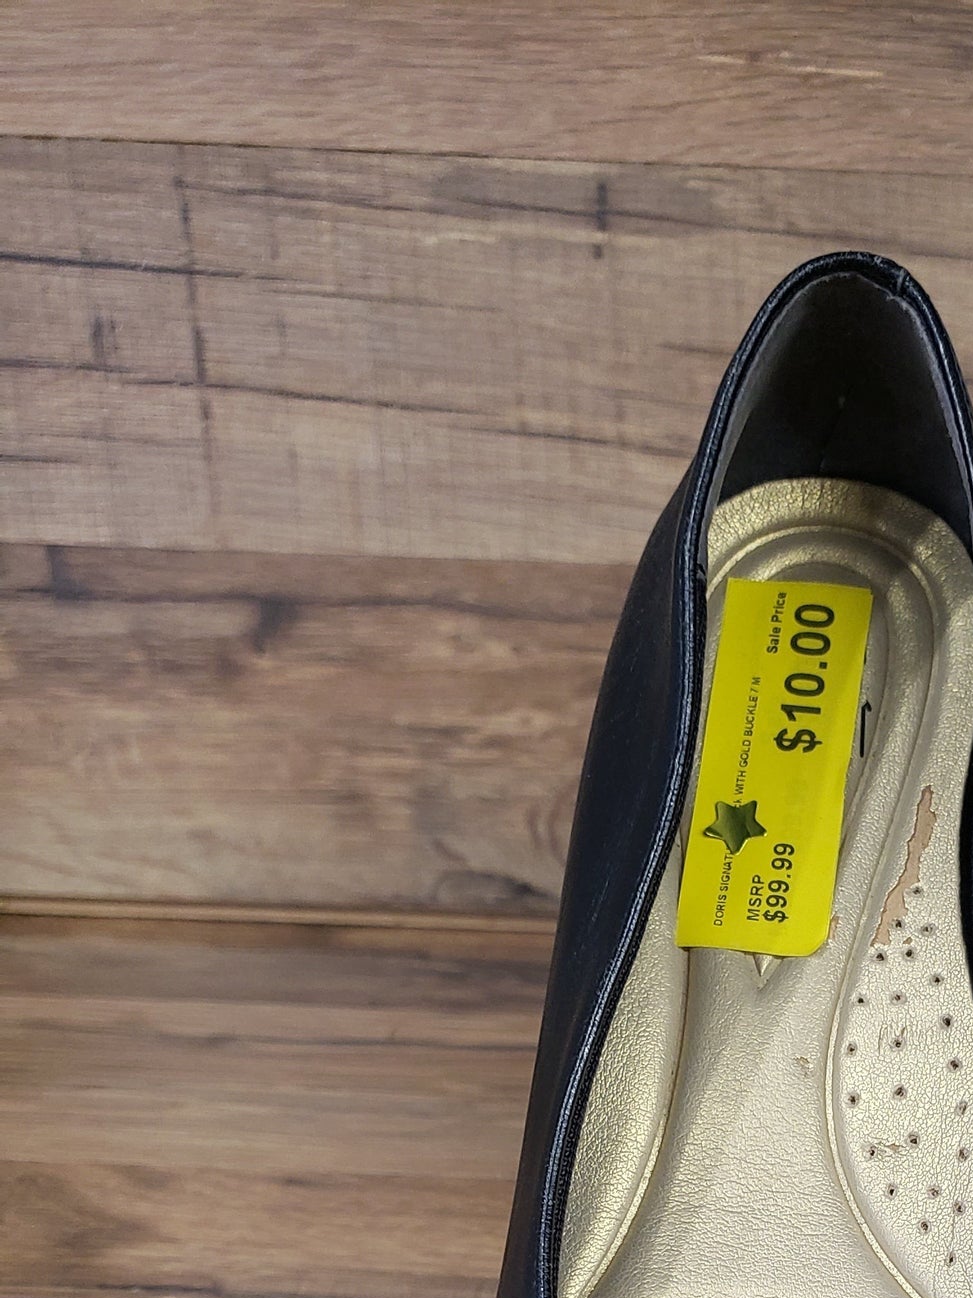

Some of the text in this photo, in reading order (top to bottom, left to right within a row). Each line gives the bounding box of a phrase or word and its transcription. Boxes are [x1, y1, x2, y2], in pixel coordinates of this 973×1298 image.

[766, 592, 787, 654] Sale Price
[753, 676, 761, 686] M
[774, 603, 835, 753] $10.00
[749, 695, 760, 737] BUCKLE
[739, 739, 752, 767] GOLD
[734, 771, 746, 795] WITH
[747, 875, 765, 922] MSRP
[763, 843, 795, 923] $99.99
[713, 895, 727, 926] DORIS
